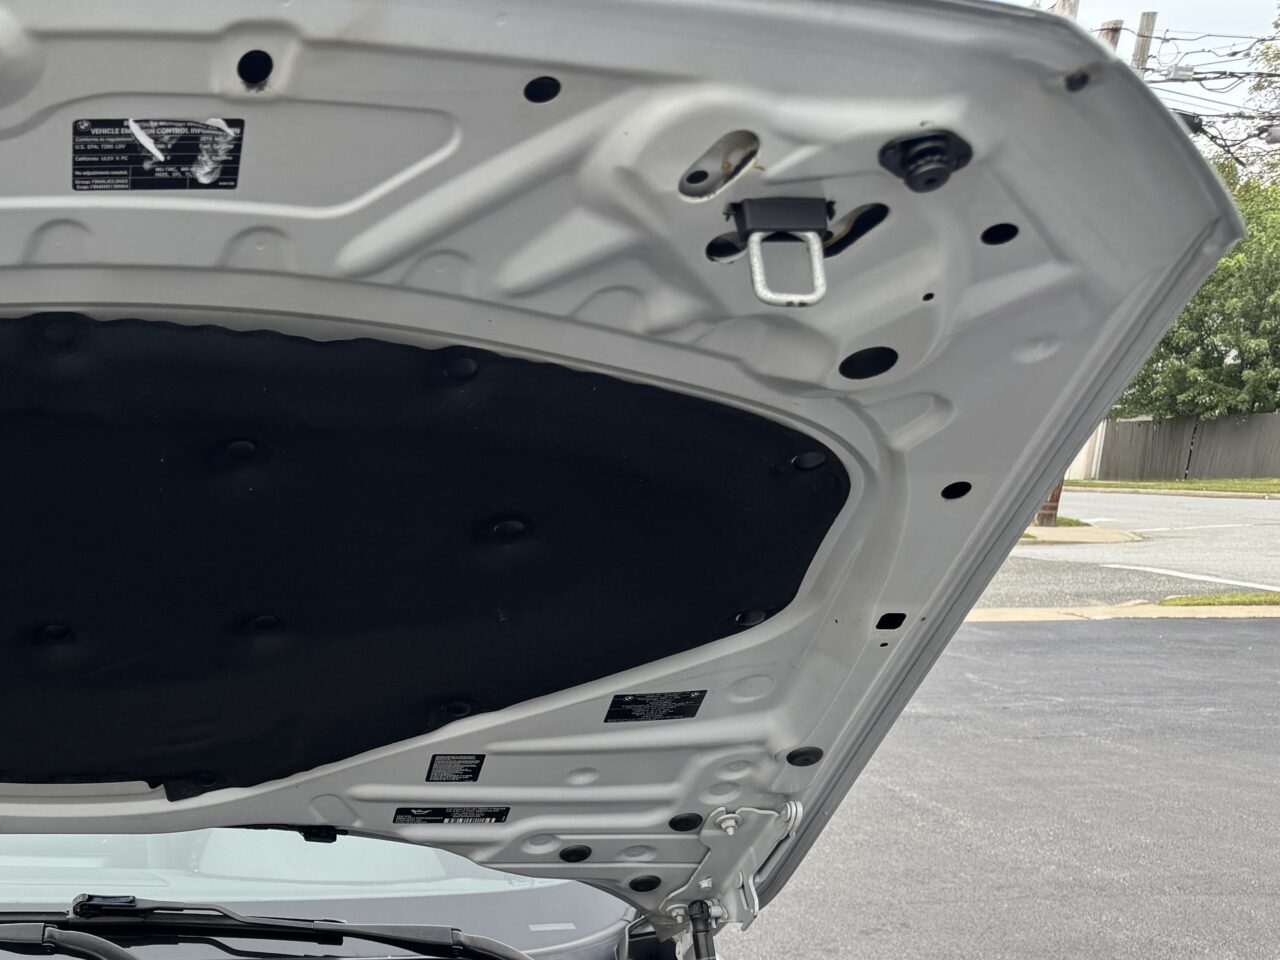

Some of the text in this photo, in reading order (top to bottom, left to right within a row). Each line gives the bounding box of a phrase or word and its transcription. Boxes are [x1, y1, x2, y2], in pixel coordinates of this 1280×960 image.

[90, 127, 119, 135] VEHICLE
[120, 127, 155, 135] EMION
[156, 127, 189, 135] CONTROL
